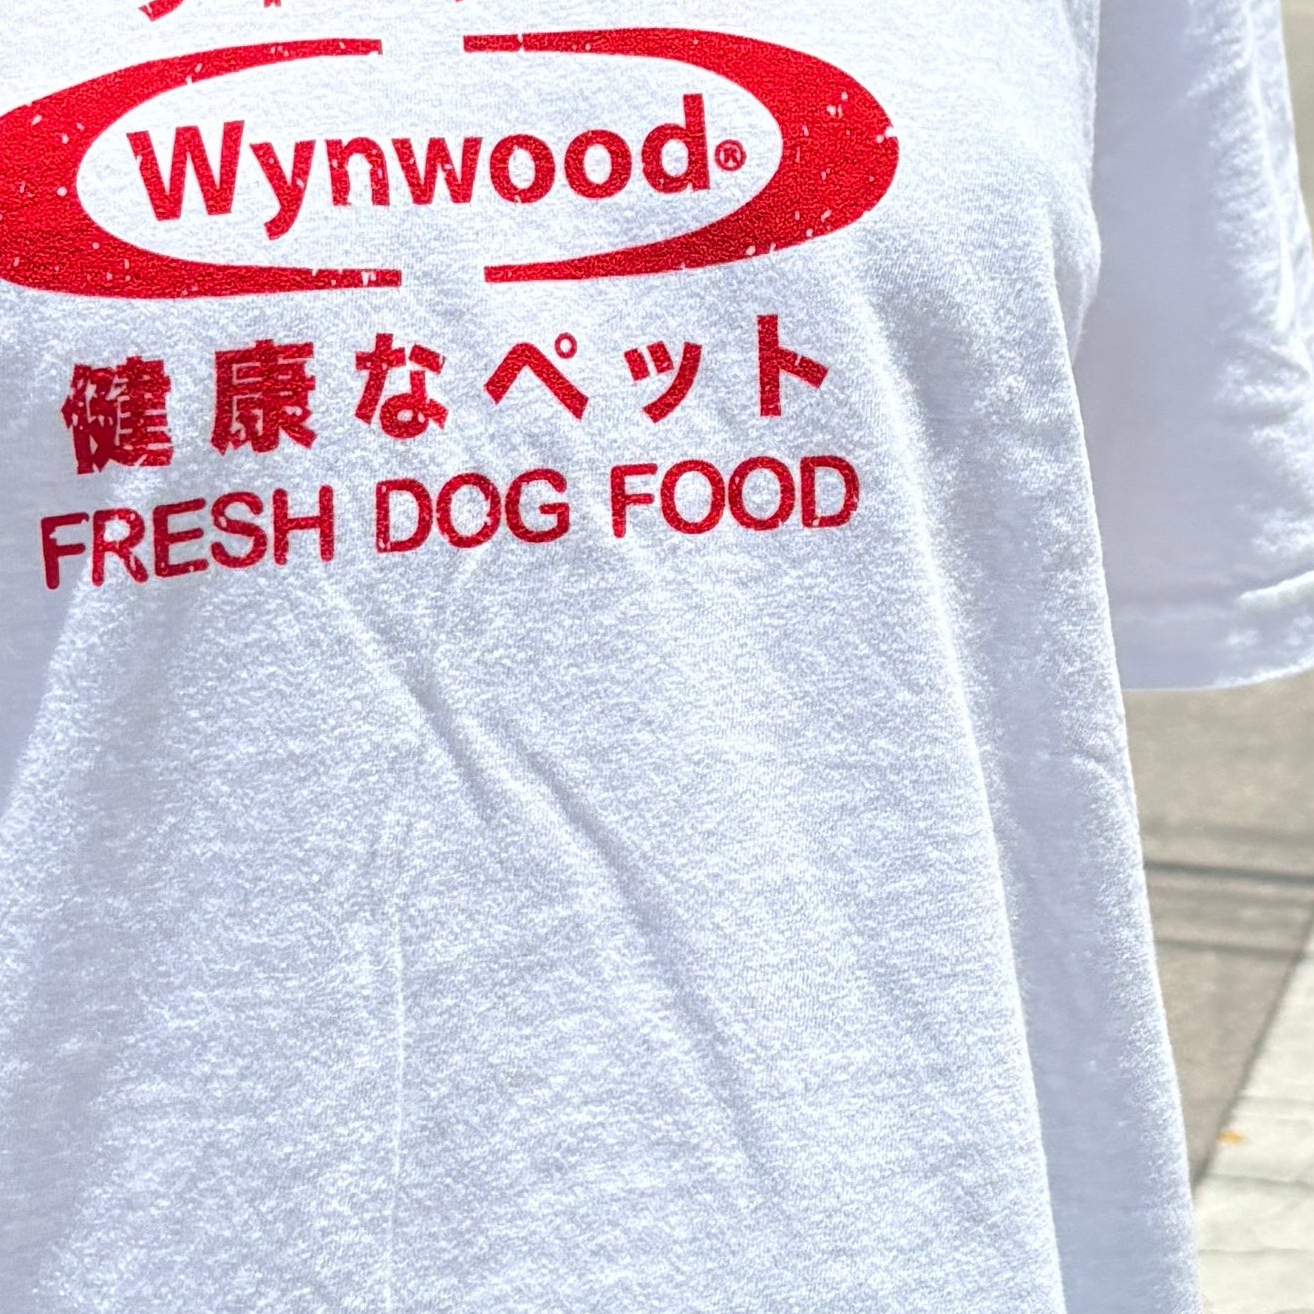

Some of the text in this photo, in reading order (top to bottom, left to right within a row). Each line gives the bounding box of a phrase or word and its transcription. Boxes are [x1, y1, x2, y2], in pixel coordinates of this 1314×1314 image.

[60, 314, 829, 476] 健康なペット
[39, 454, 861, 591] FRESH DOG FOOD
